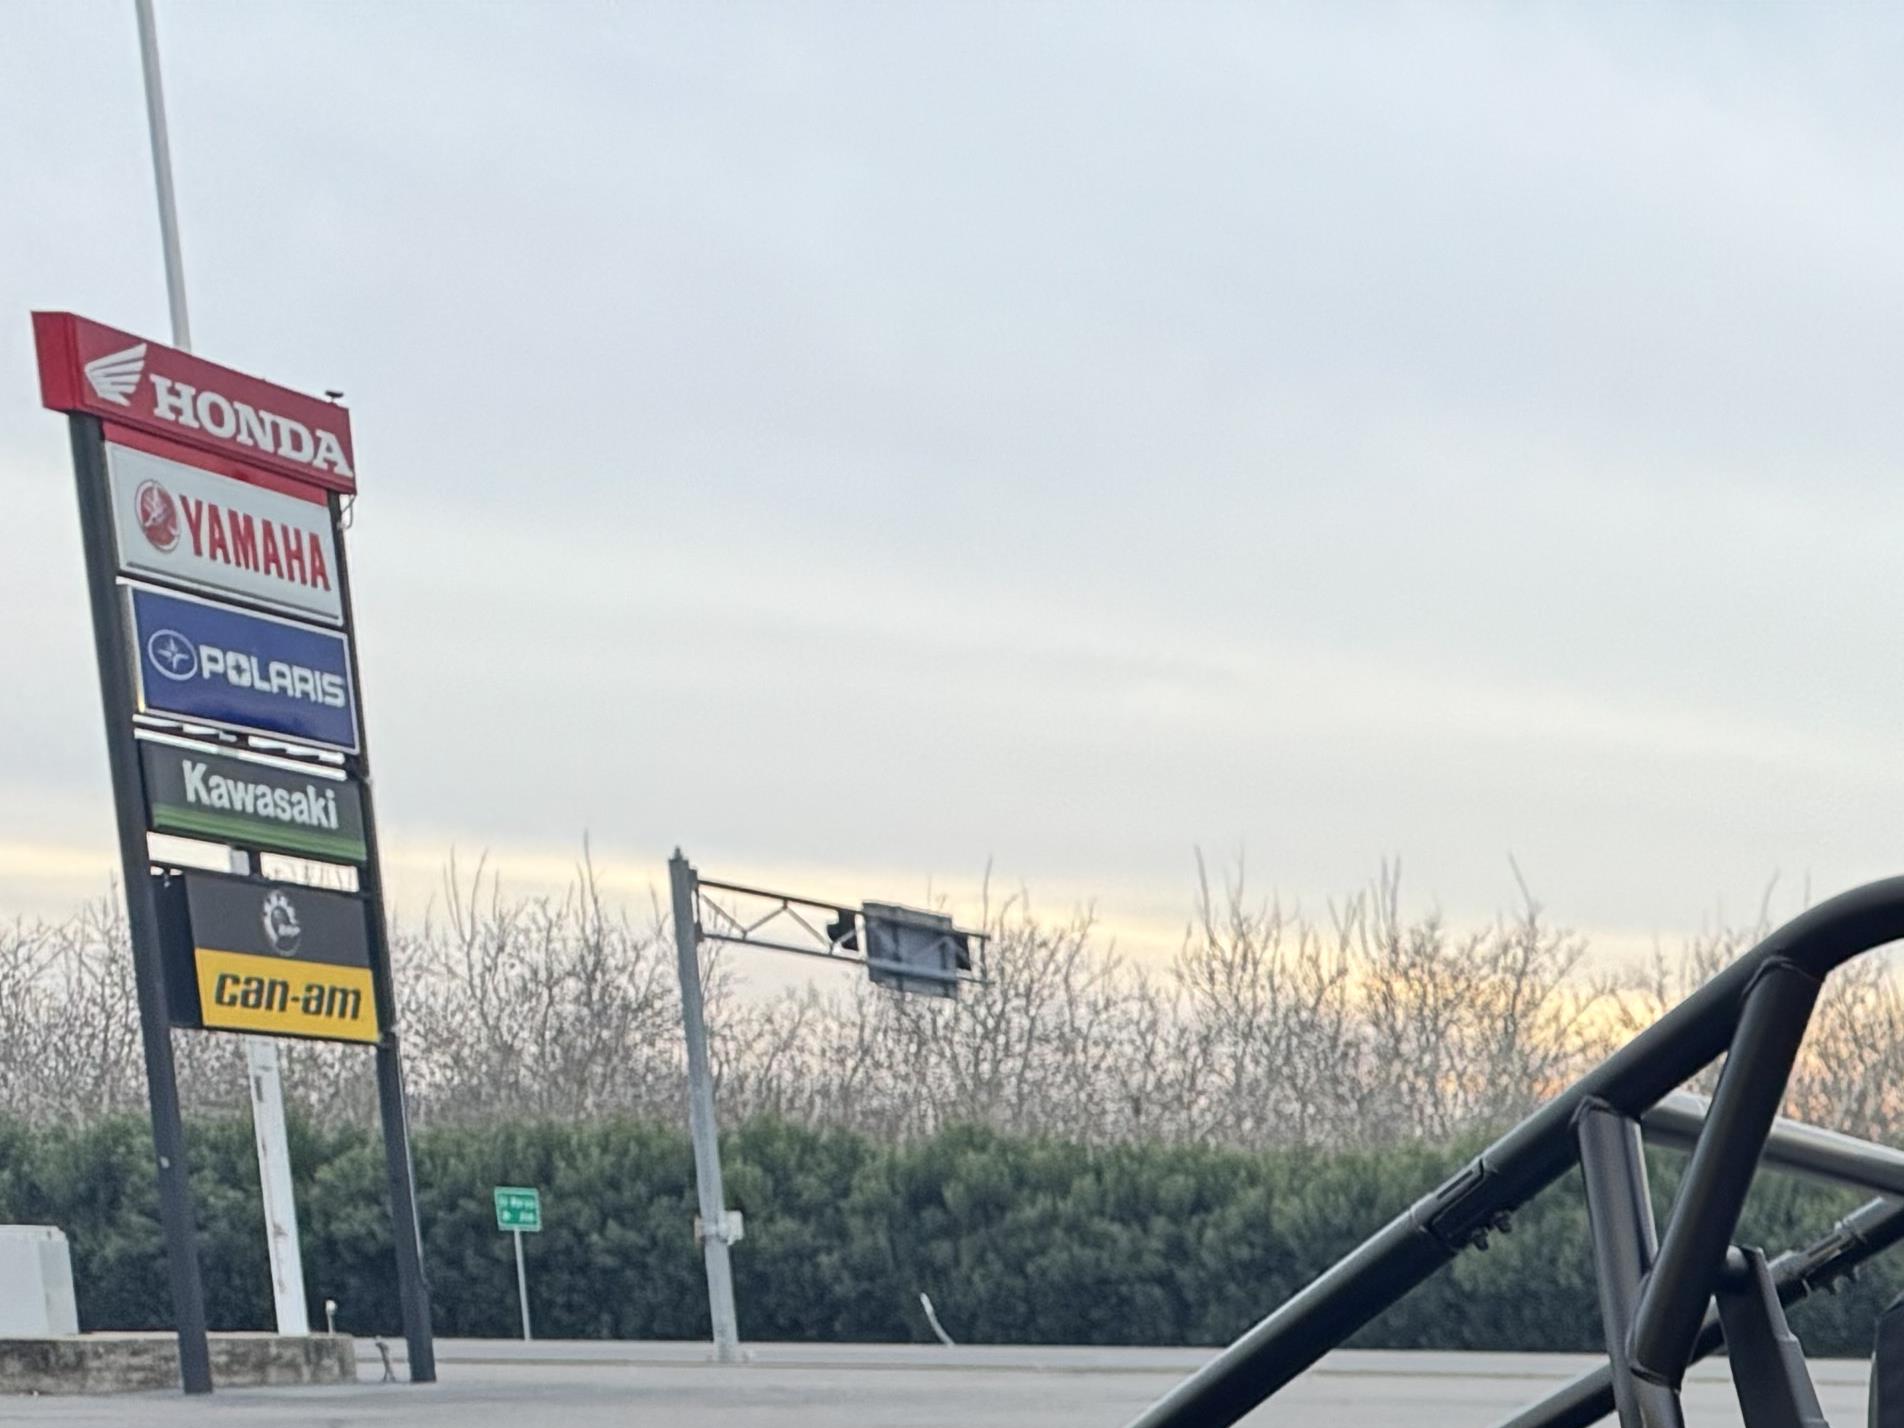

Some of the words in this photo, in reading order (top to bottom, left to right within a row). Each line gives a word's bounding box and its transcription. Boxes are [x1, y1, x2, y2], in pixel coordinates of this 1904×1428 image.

[150, 373, 353, 477] HONDA
[180, 494, 331, 592] YAMAHA
[199, 645, 345, 708] POLARIS
[182, 760, 338, 830] Kawasaki
[215, 972, 361, 1020] can-am
